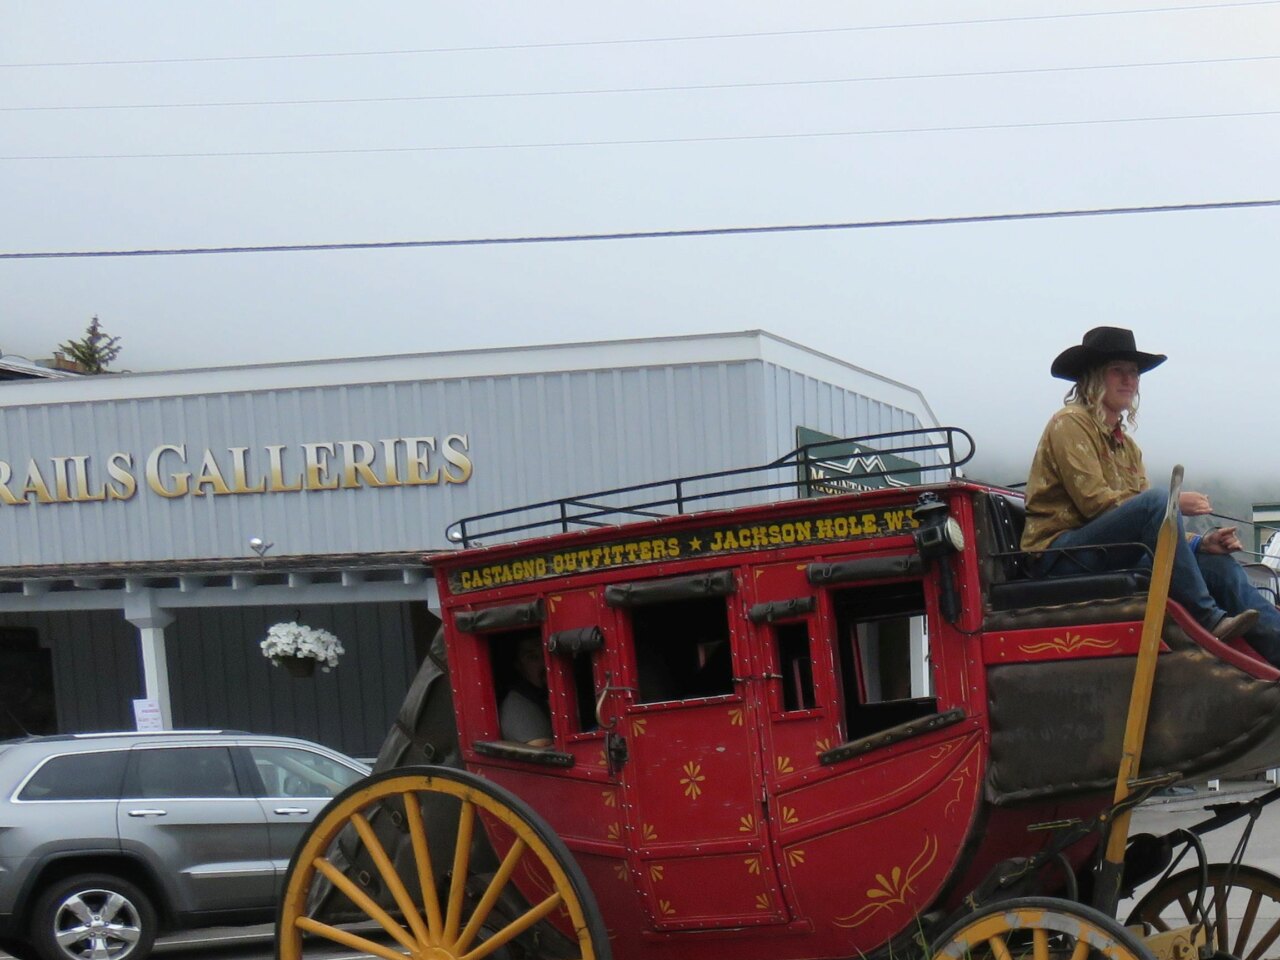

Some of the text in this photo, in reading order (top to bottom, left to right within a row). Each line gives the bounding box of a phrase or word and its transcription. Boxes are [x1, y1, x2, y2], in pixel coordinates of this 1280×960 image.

[146, 434, 473, 498] GALLERIES
[461, 557, 547, 589] CASTAGNO
[552, 537, 680, 574] OUTFITTERS
[710, 520, 812, 551] JACKSON
